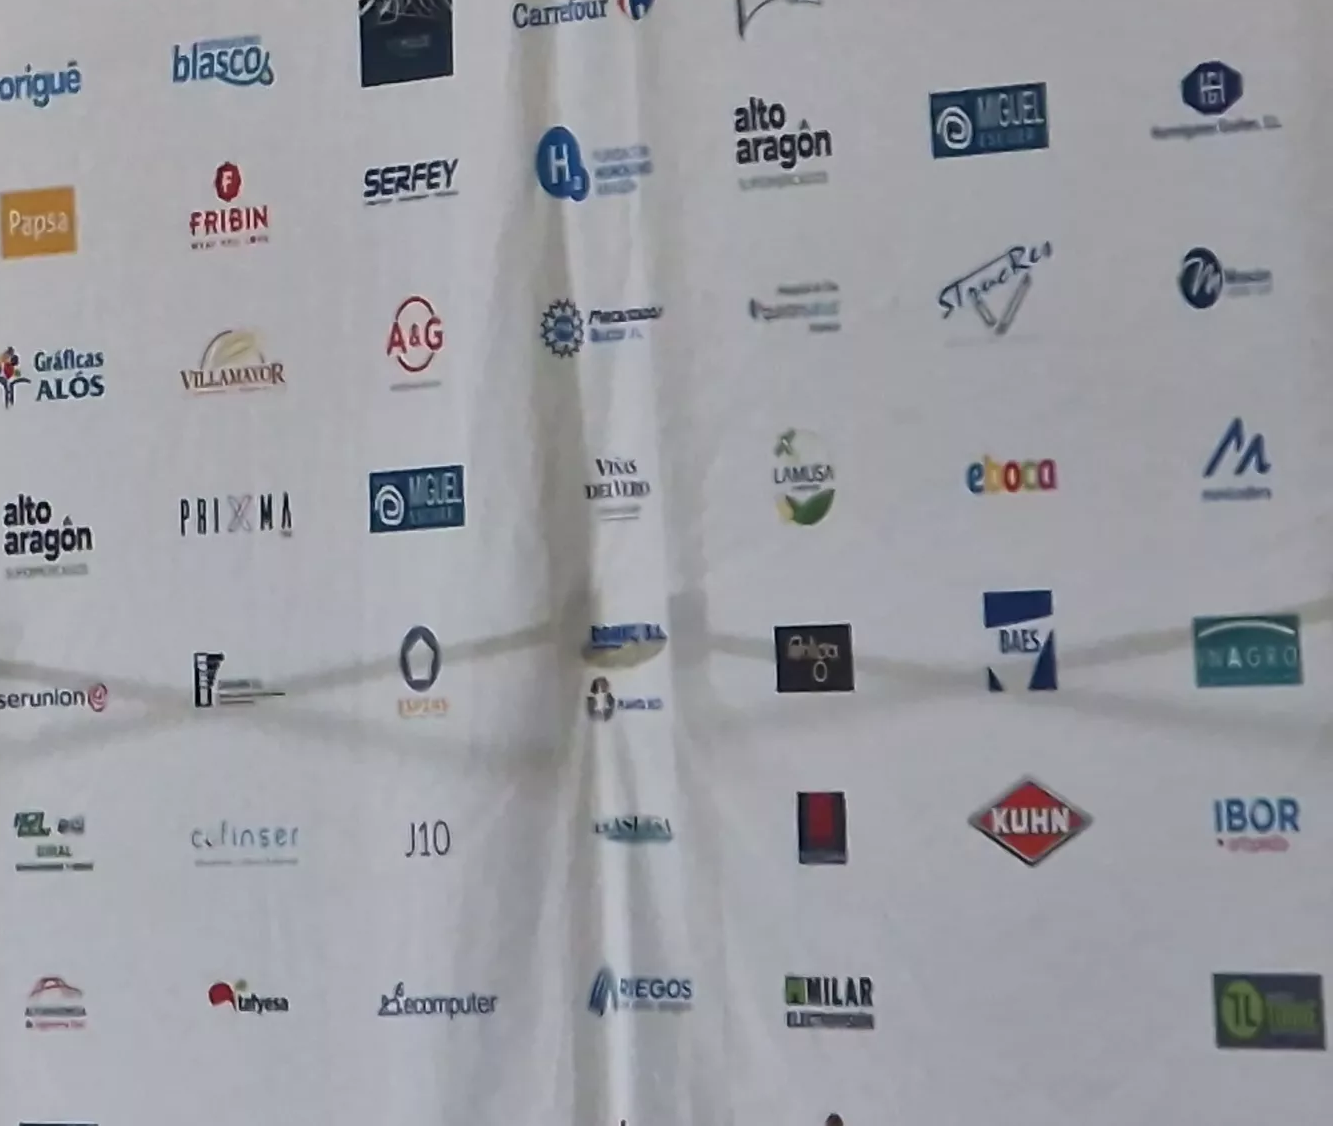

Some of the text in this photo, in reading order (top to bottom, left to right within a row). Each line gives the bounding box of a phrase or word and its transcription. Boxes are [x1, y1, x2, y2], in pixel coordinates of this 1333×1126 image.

[734, 97, 787, 134] alto
[363, 158, 460, 199] SERFEY
[9, 209, 70, 240] Papsa
[189, 204, 270, 237] FRIBIN
[35, 372, 106, 403] ALÓS
[179, 362, 287, 392] VILLAMAYOR
[3, 493, 53, 527] alto
[990, 806, 1072, 835] KUHN
[1214, 797, 1301, 834] IBOR
[405, 819, 452, 859] J10
